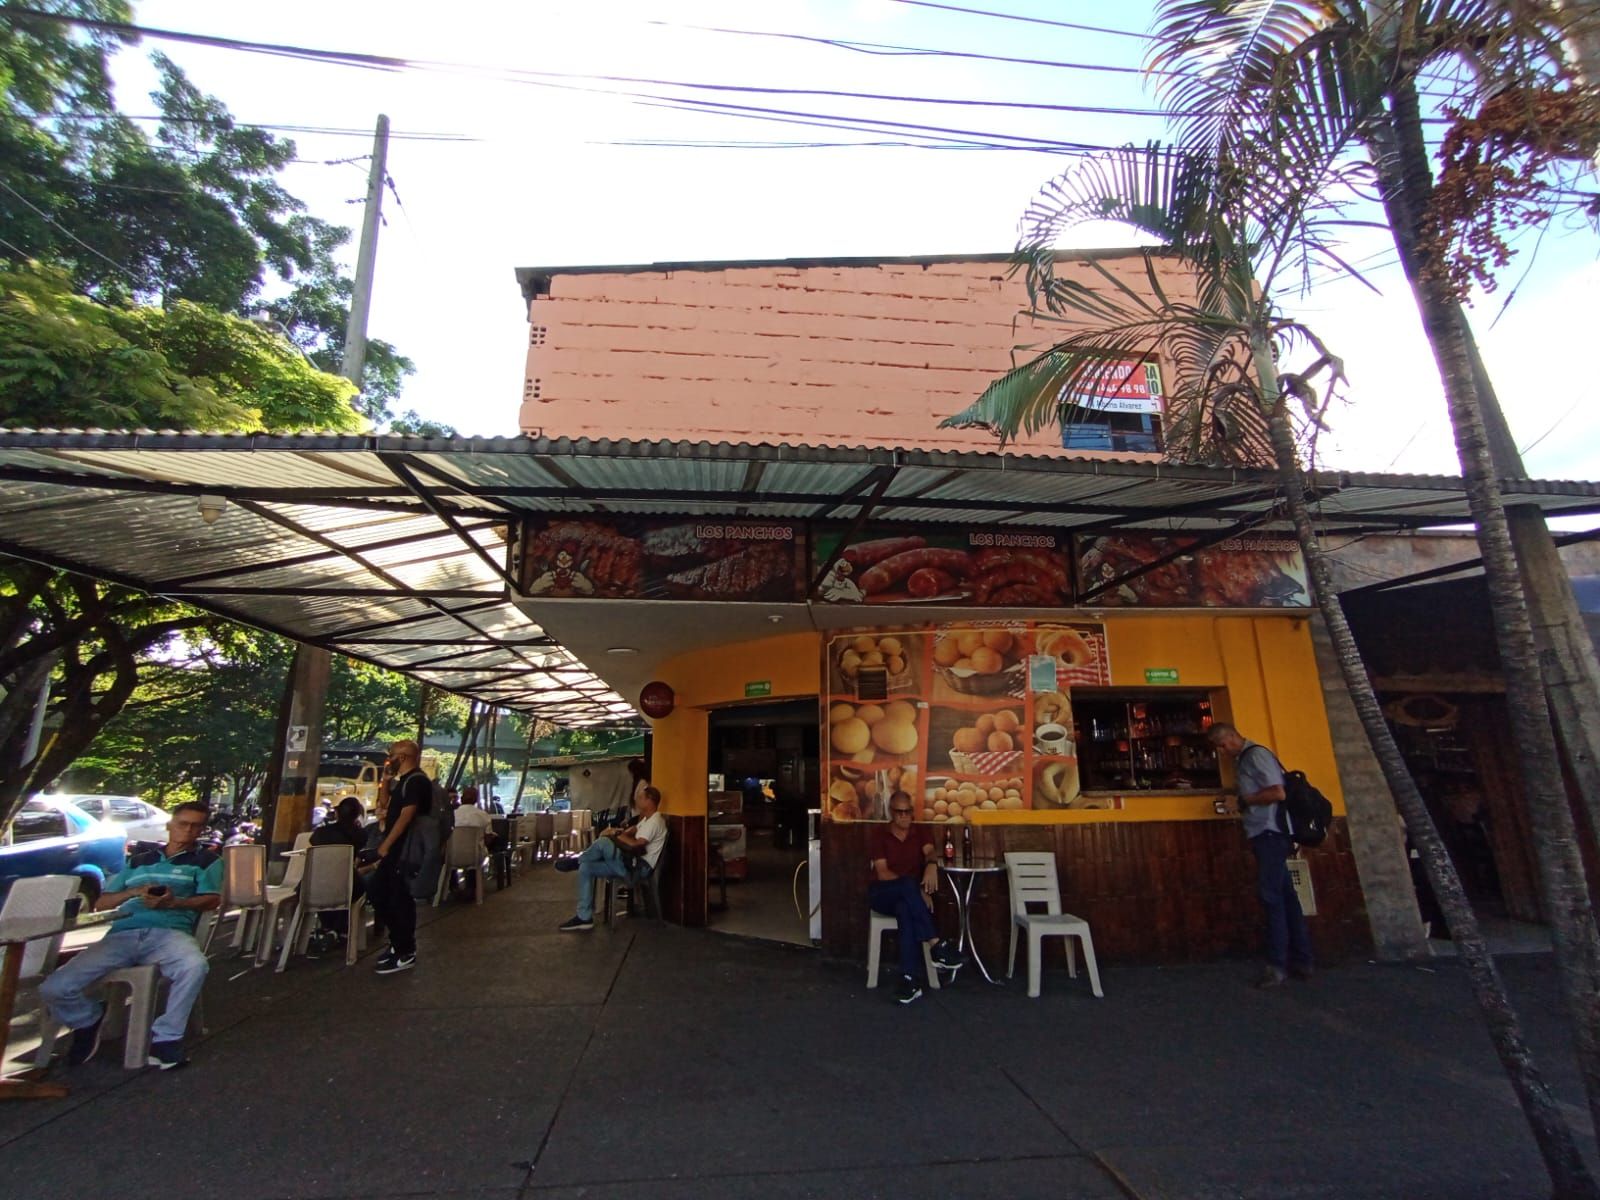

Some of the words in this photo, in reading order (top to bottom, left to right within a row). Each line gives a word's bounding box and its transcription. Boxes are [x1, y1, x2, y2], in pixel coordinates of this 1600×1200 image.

[696, 525, 723, 539] LOS
[725, 526, 793, 540] PANCHOS
[969, 533, 994, 546] LOS
[995, 534, 1056, 548] PANCHOS
[1220, 539, 1242, 551] LOS
[1243, 539, 1299, 552] PANCHOS
